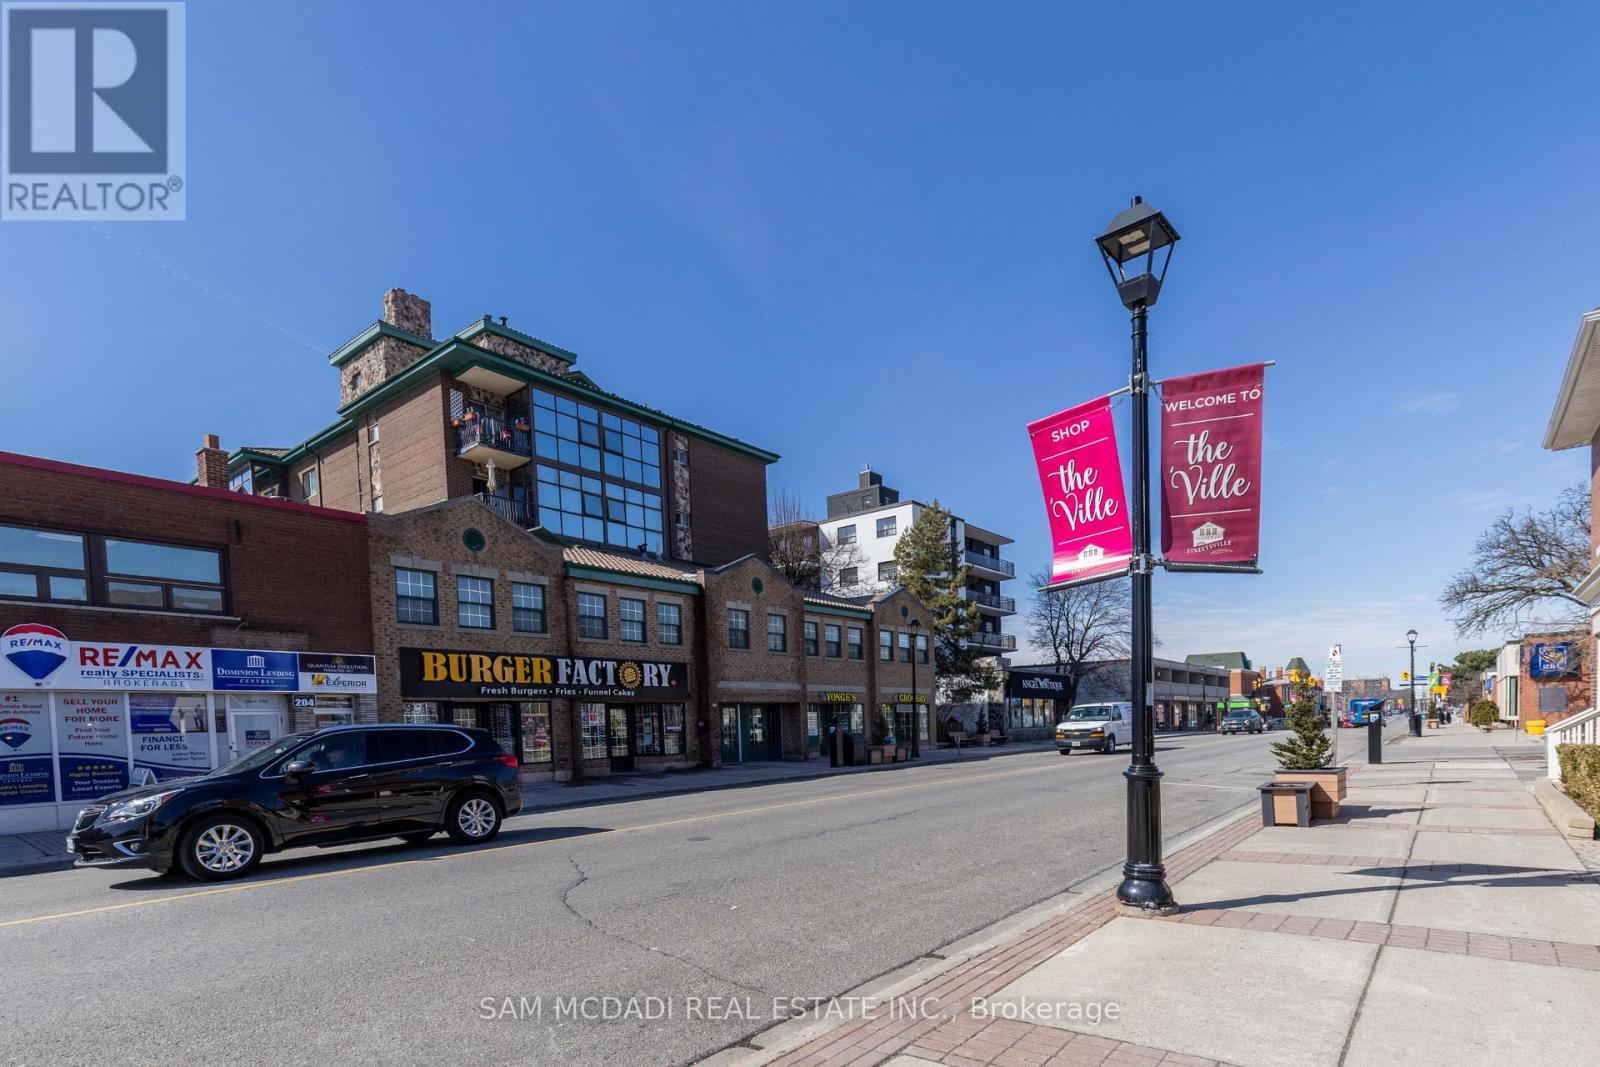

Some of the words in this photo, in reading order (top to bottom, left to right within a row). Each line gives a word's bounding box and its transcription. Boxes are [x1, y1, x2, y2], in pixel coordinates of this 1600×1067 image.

[1165, 393, 1236, 412] WELCOME
[1240, 389, 1261, 399] TO
[1051, 420, 1090, 442] SHOP
[1174, 430, 1233, 465] the
[1048, 459, 1097, 494] the
[1186, 540, 1233, 554] STREETSVILLE
[9, 638, 62, 649] RE/MAX
[79, 646, 203, 669] RE/MAX
[81, 669, 117, 678] realty
[122, 670, 200, 678] SPECIALISTS
[217, 667, 259, 676] DOMINION
[261, 669, 295, 677] LENDING
[421, 652, 552, 684] BURGER
[326, 676, 367, 686] EXPERIOR
[511, 687, 547, 695] Burgers
[295, 698, 315, 707] 204
[899, 694, 929, 702] GROERY
